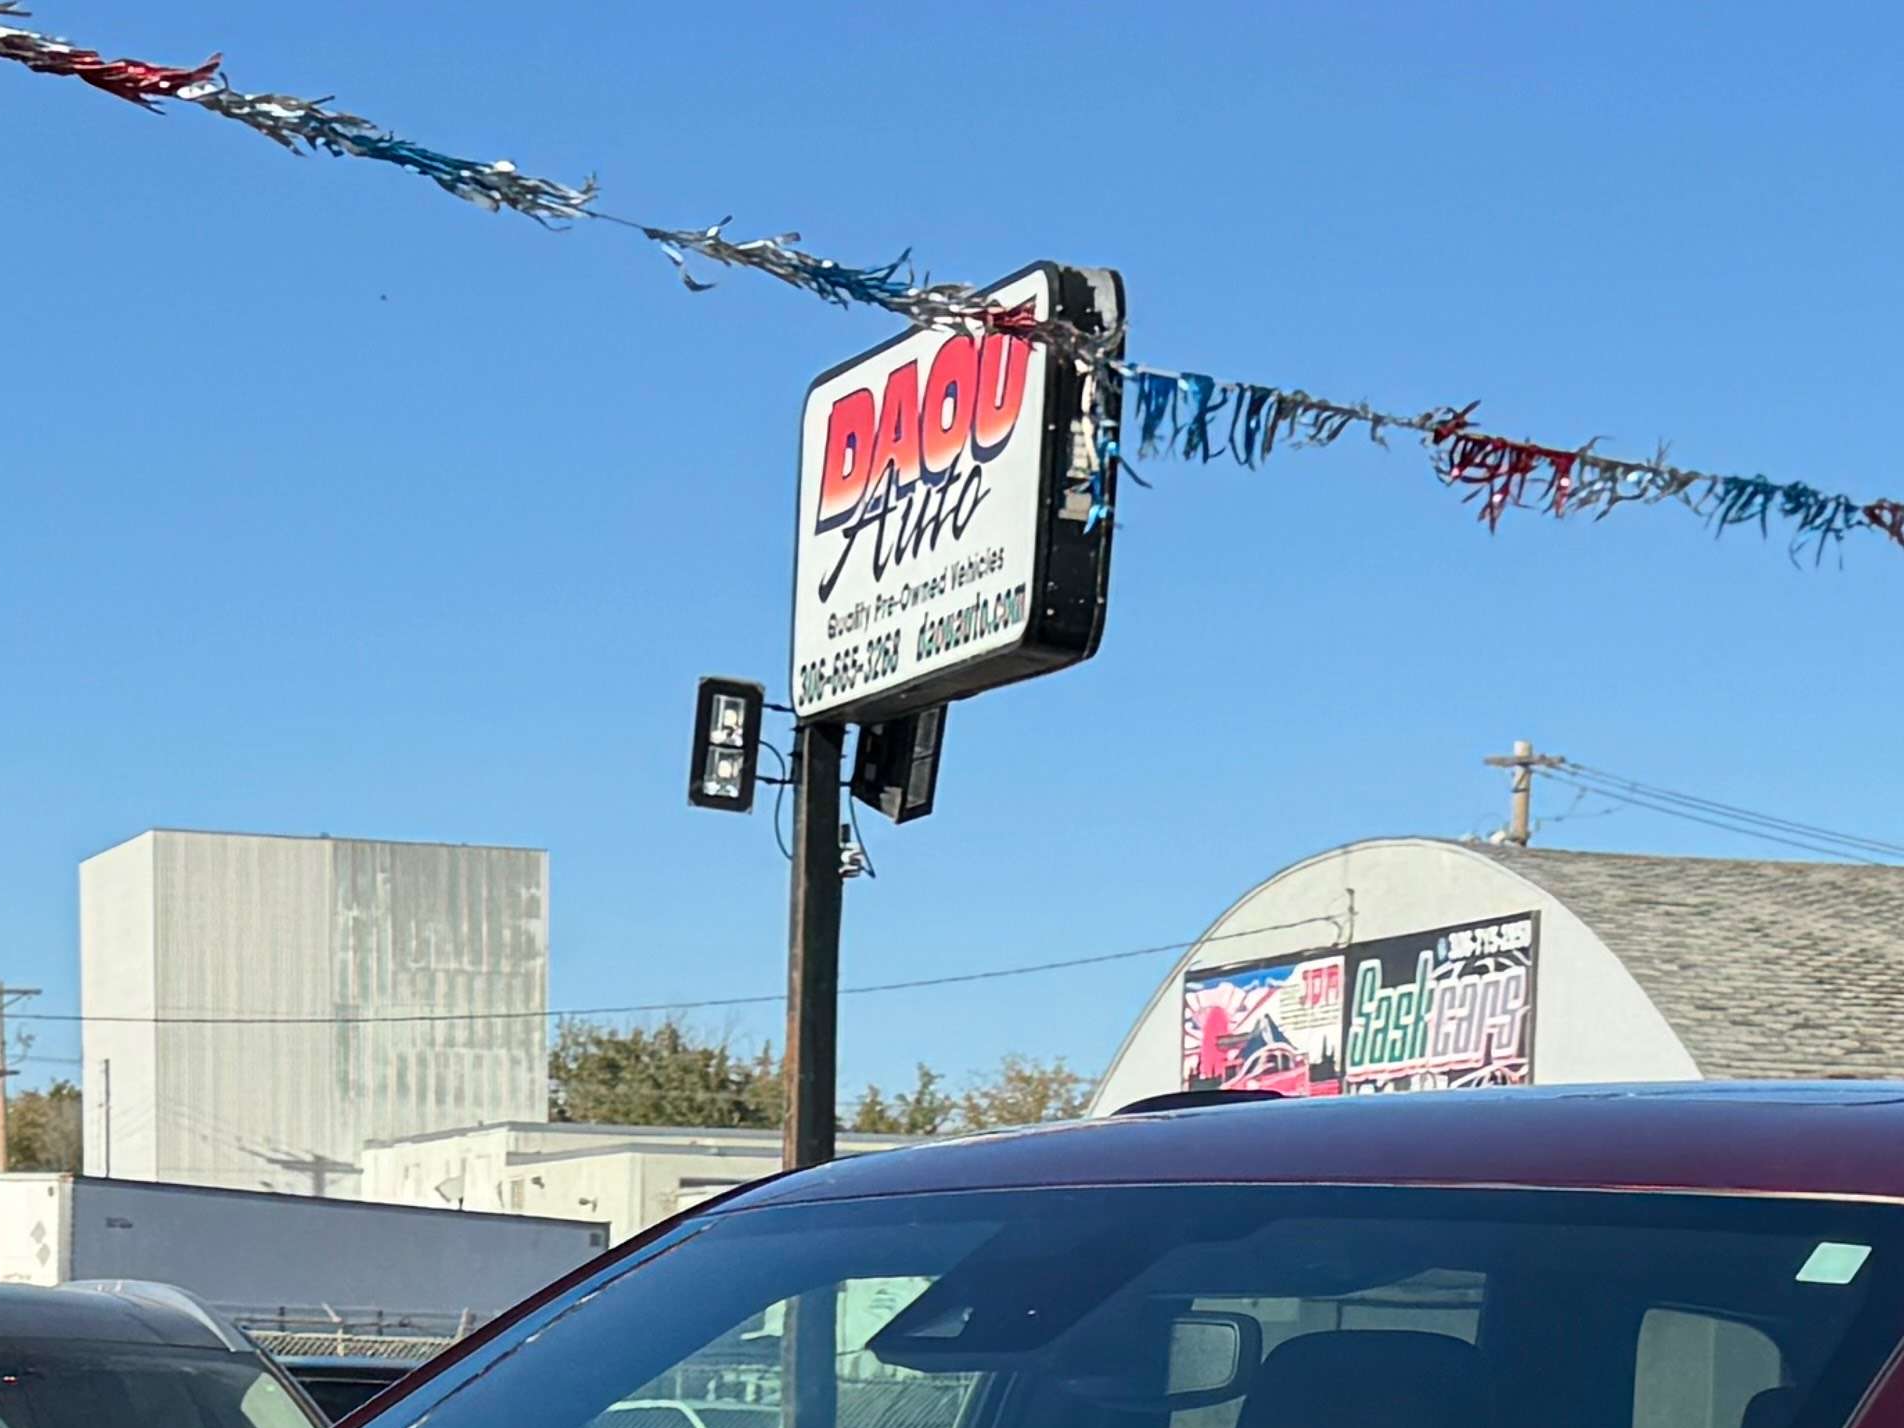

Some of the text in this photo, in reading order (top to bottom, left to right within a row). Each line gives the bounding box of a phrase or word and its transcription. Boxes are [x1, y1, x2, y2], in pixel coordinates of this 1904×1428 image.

[815, 320, 1034, 535] DAOU
[819, 455, 991, 603] Auto
[828, 547, 1005, 639] Quality Pre-Owned Vehicles
[915, 582, 1027, 662] daouauto.com
